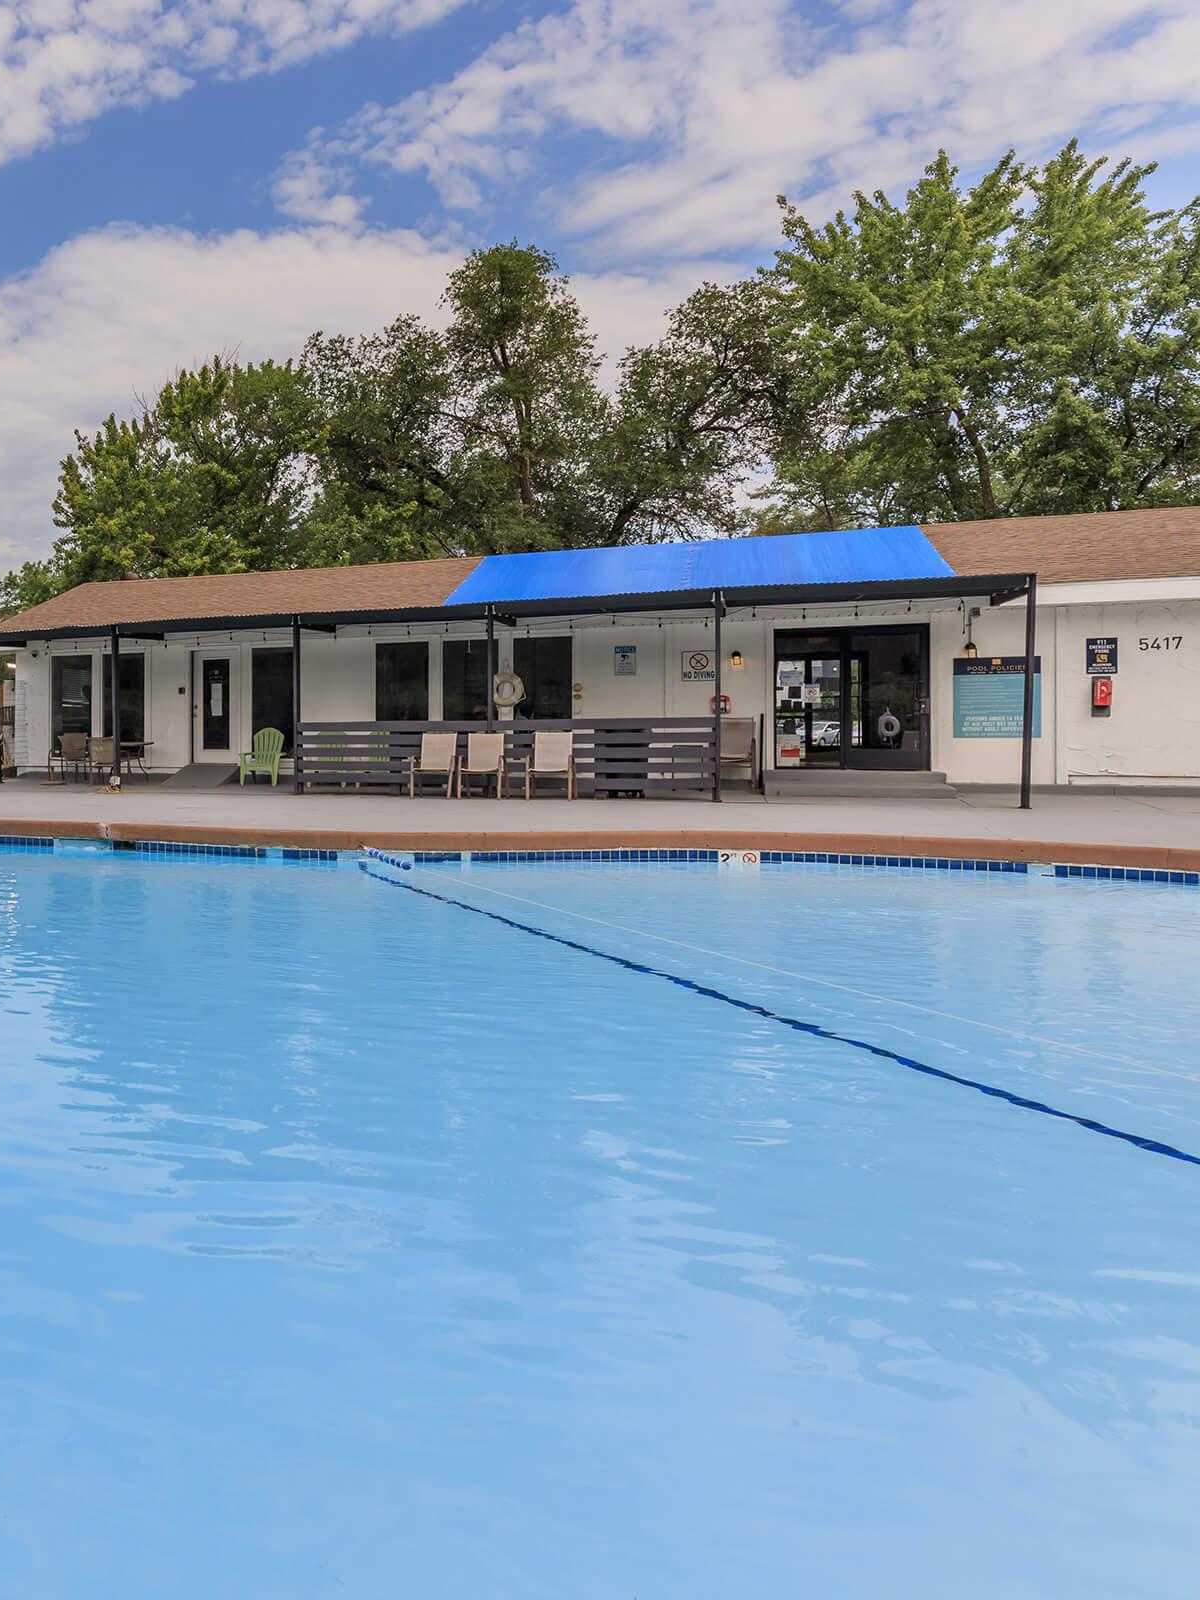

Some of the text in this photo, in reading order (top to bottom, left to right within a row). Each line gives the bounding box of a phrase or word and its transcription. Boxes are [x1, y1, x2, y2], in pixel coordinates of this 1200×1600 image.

[1139, 636, 1182, 650] 5417
[683, 670, 715, 679] NO DIVING
[720, 853, 730, 863] 2
